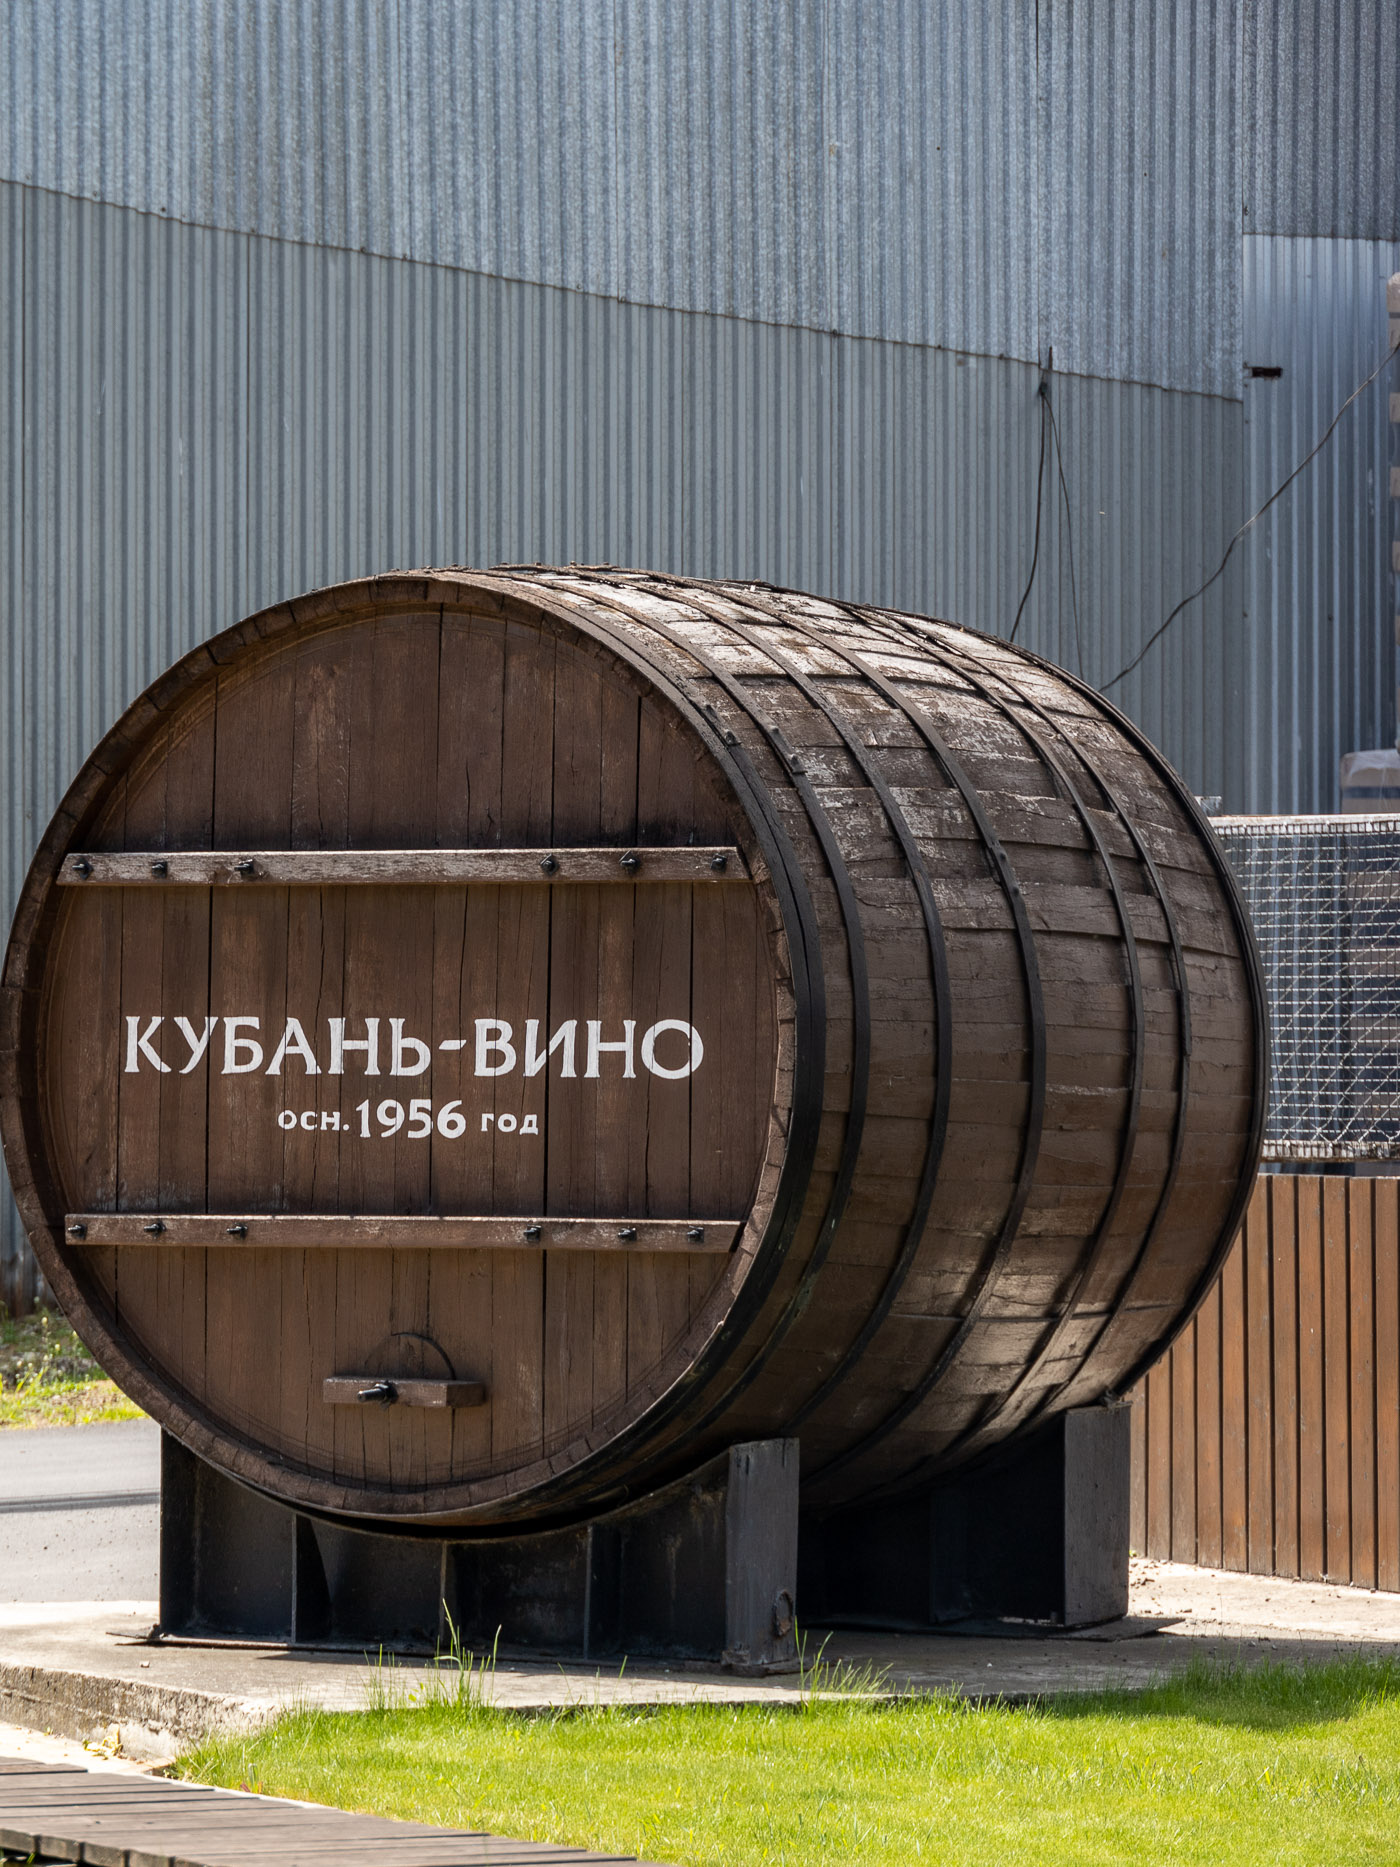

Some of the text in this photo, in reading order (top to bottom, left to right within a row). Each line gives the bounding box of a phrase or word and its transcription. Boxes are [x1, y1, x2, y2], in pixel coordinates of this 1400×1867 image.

[124, 1015, 705, 1080] КУБАНЬ-ВИНО
[355, 1098, 467, 1139] 1956
[480, 1112, 540, 1135] год
